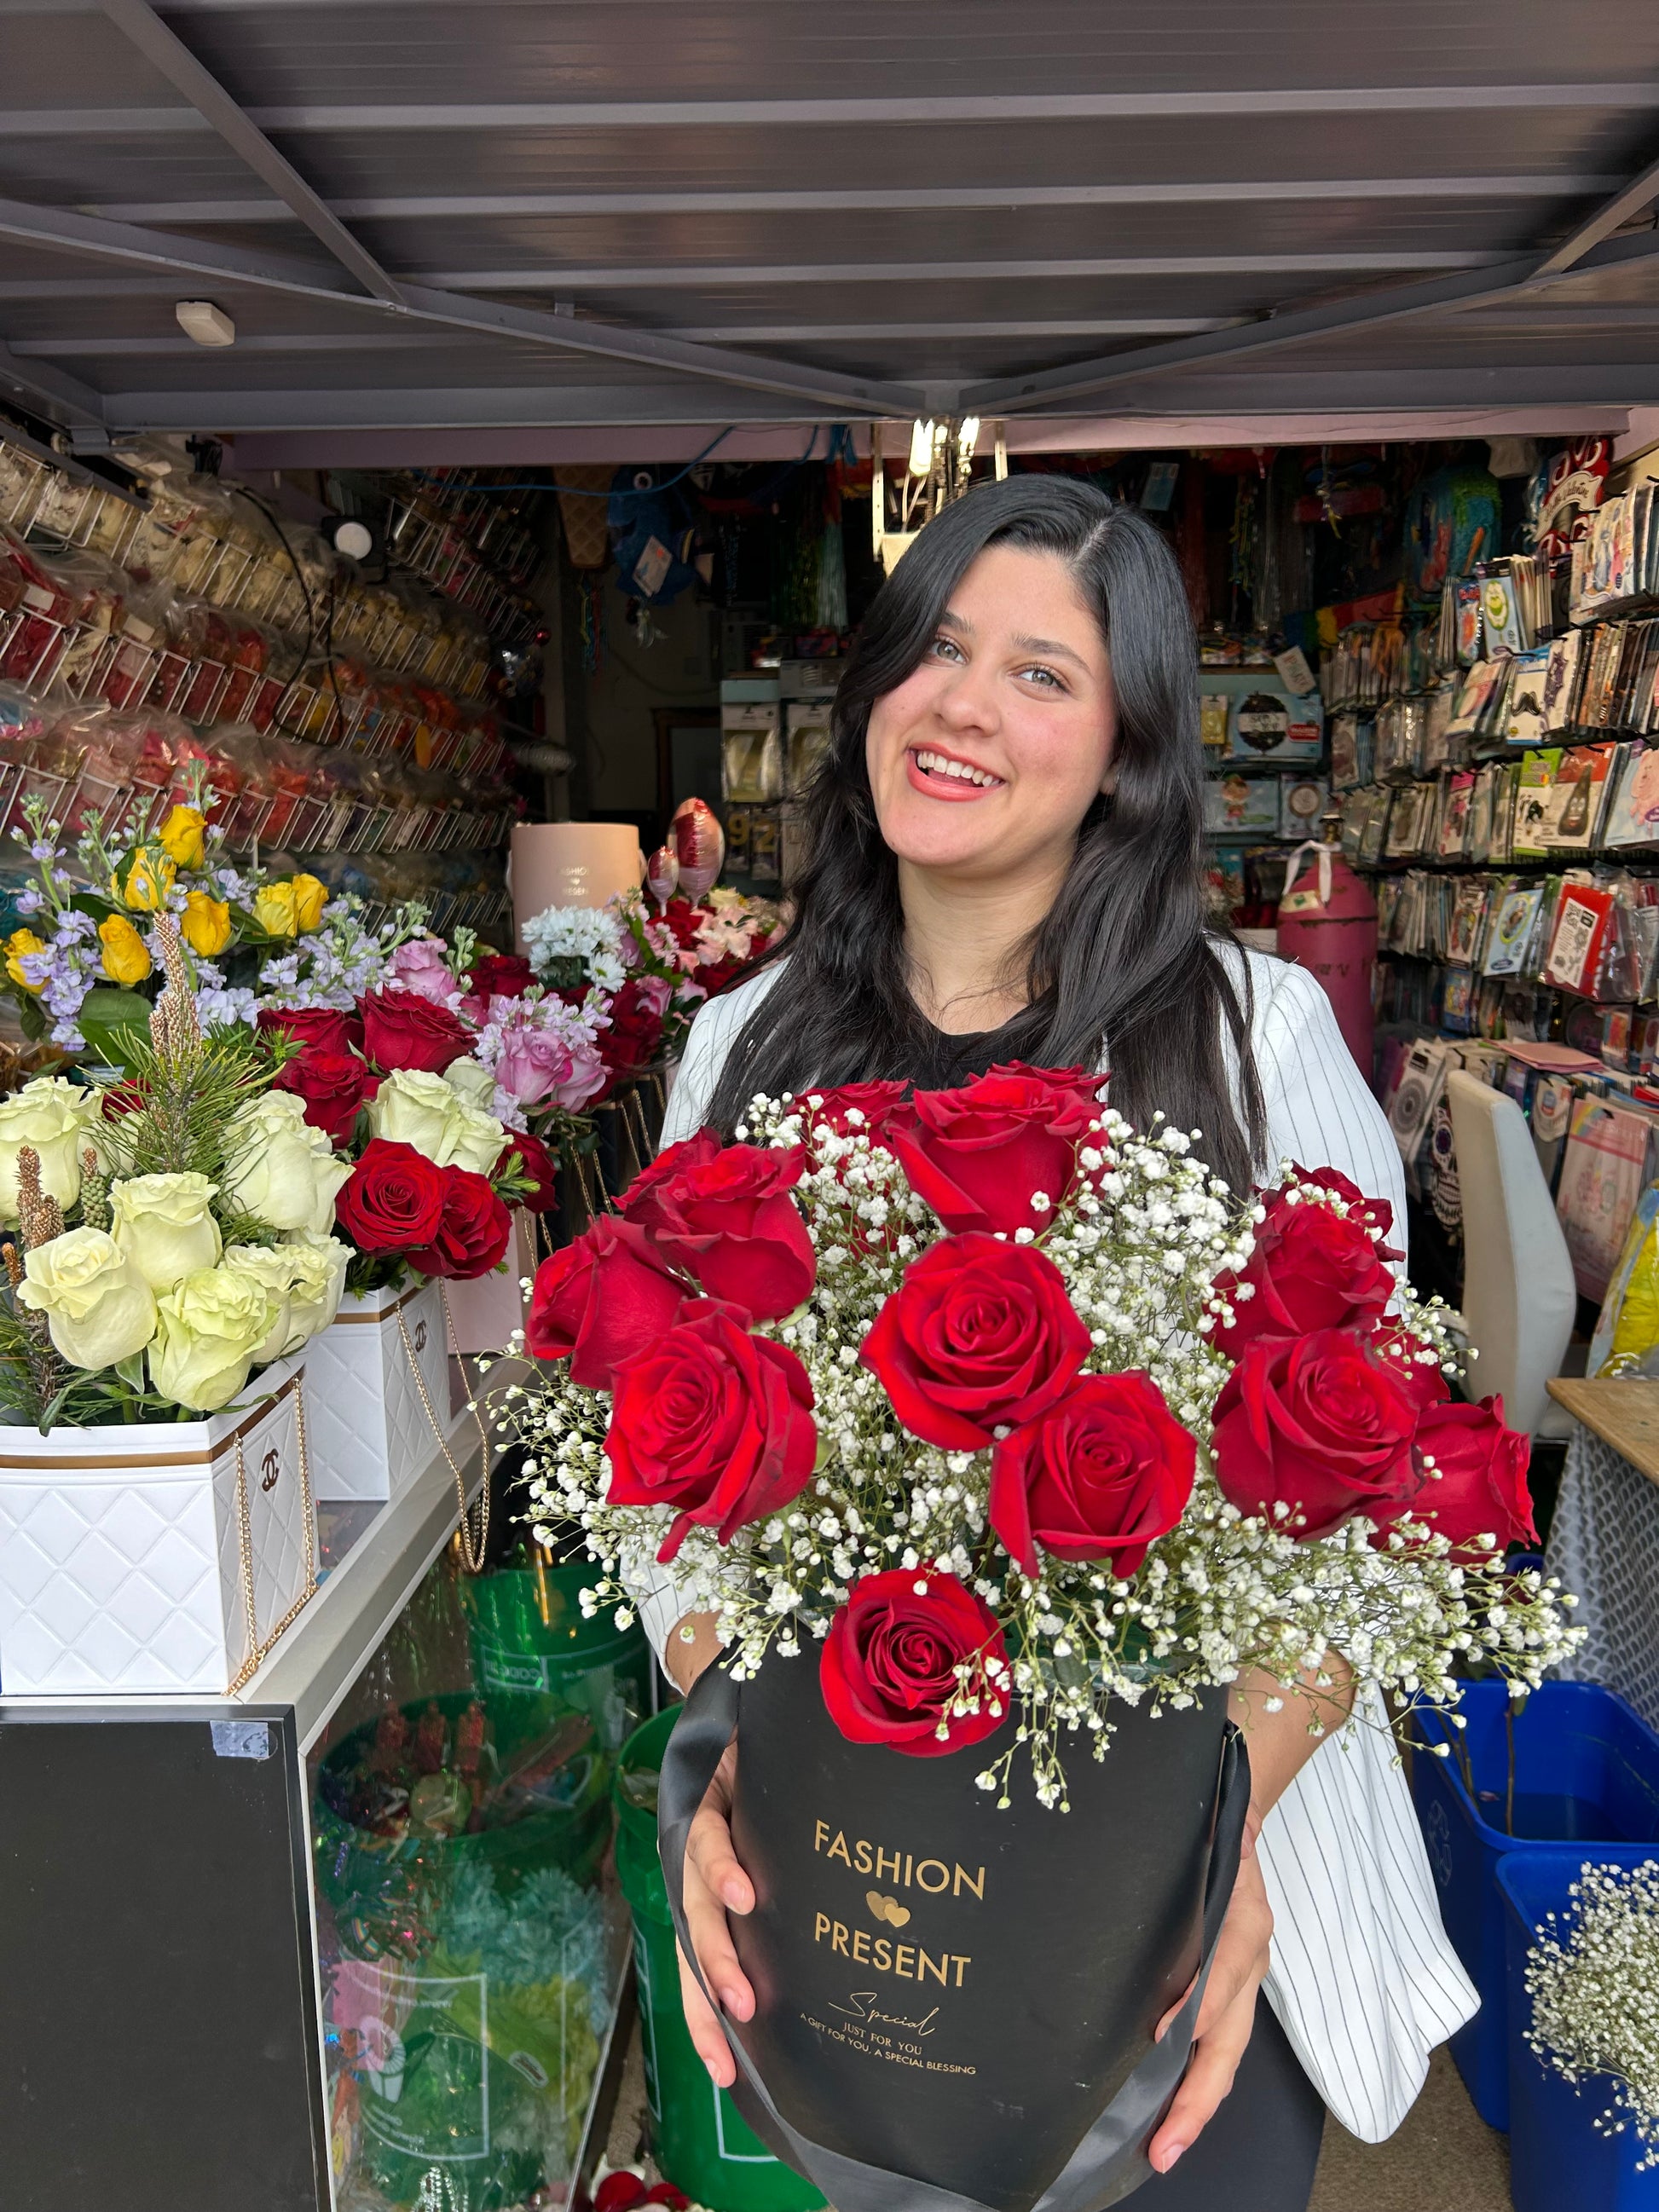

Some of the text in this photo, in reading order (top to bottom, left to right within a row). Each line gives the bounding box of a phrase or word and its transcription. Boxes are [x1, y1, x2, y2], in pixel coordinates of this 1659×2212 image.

[814, 1819, 986, 1901] FASHION
[814, 1912, 972, 1987] PRESENT
[801, 2013, 976, 2075] A GIFT FOR YOU, A SPECIAL BLESSING
[828, 1992, 939, 2036] Special
[842, 2022, 922, 2055] JUST FOR YOU
